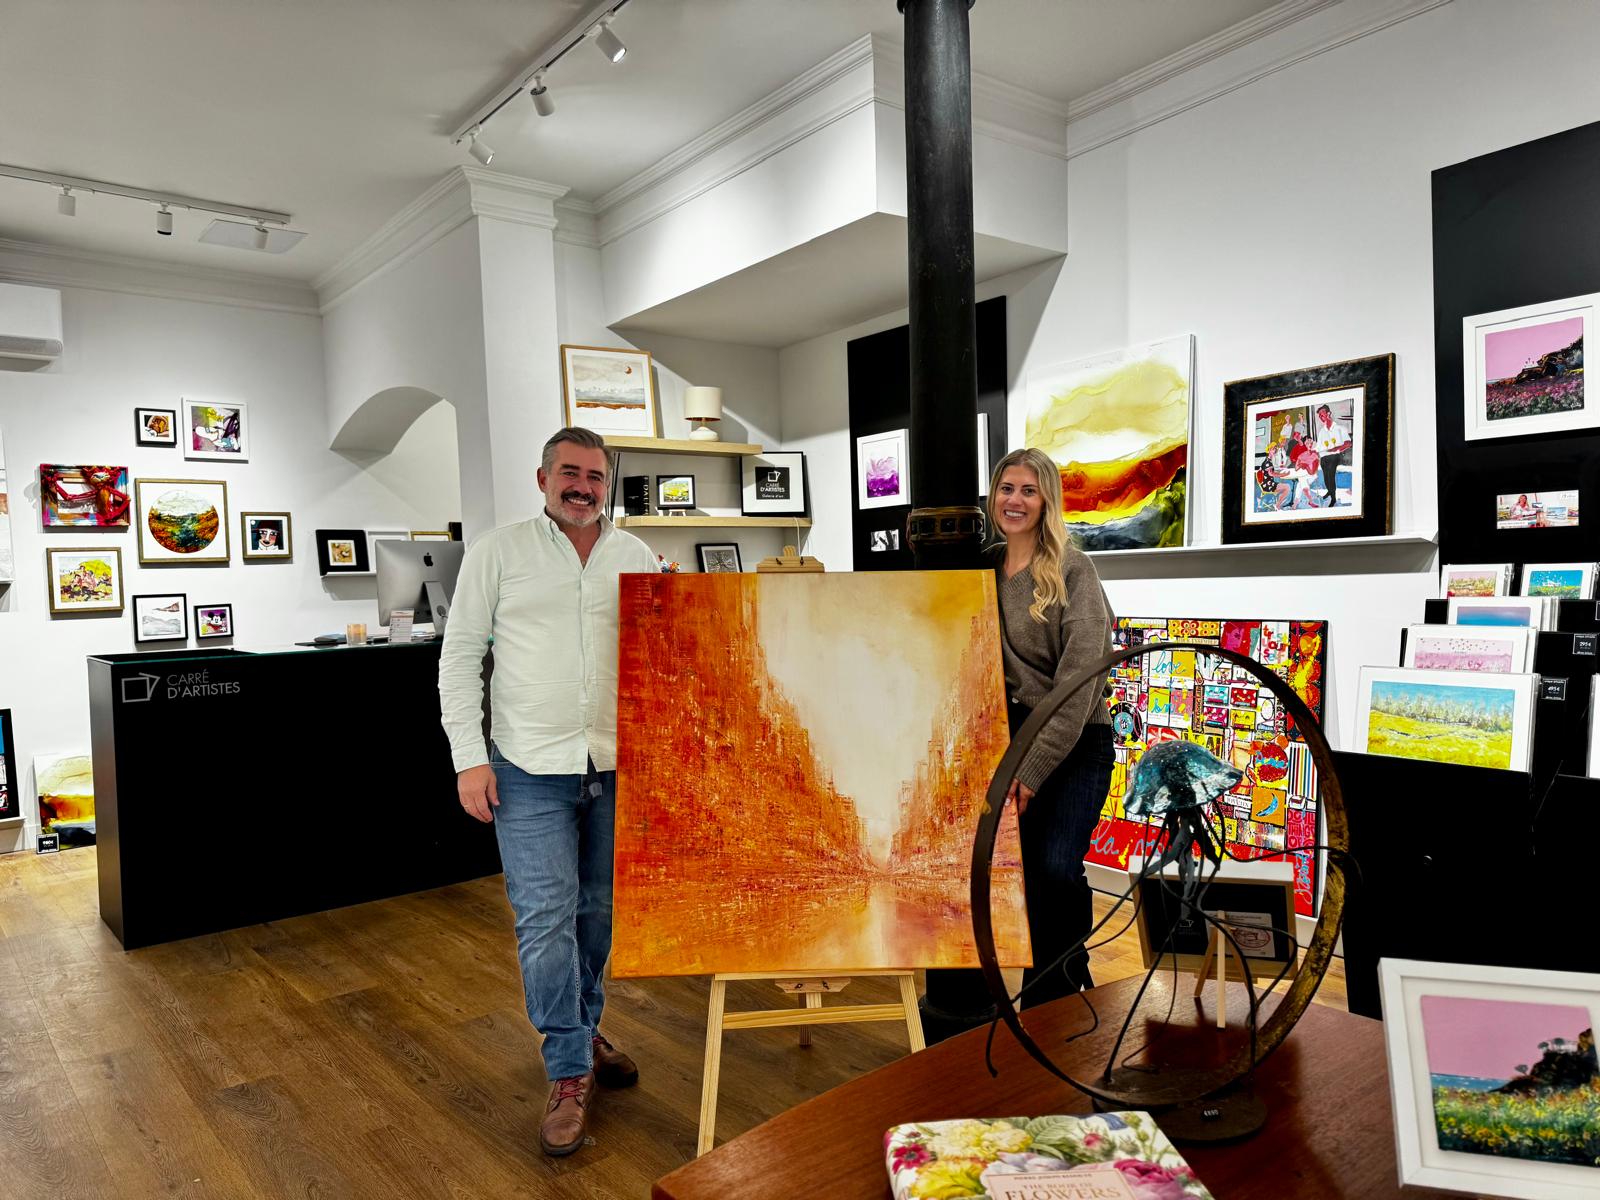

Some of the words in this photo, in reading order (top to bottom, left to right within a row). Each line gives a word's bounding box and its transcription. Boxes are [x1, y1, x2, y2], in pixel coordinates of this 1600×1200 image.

[167, 668, 210, 686] CARRÉ
[167, 681, 241, 699] D'ARTISTES
[1005, 1187, 1122, 1200] FLOWERS
